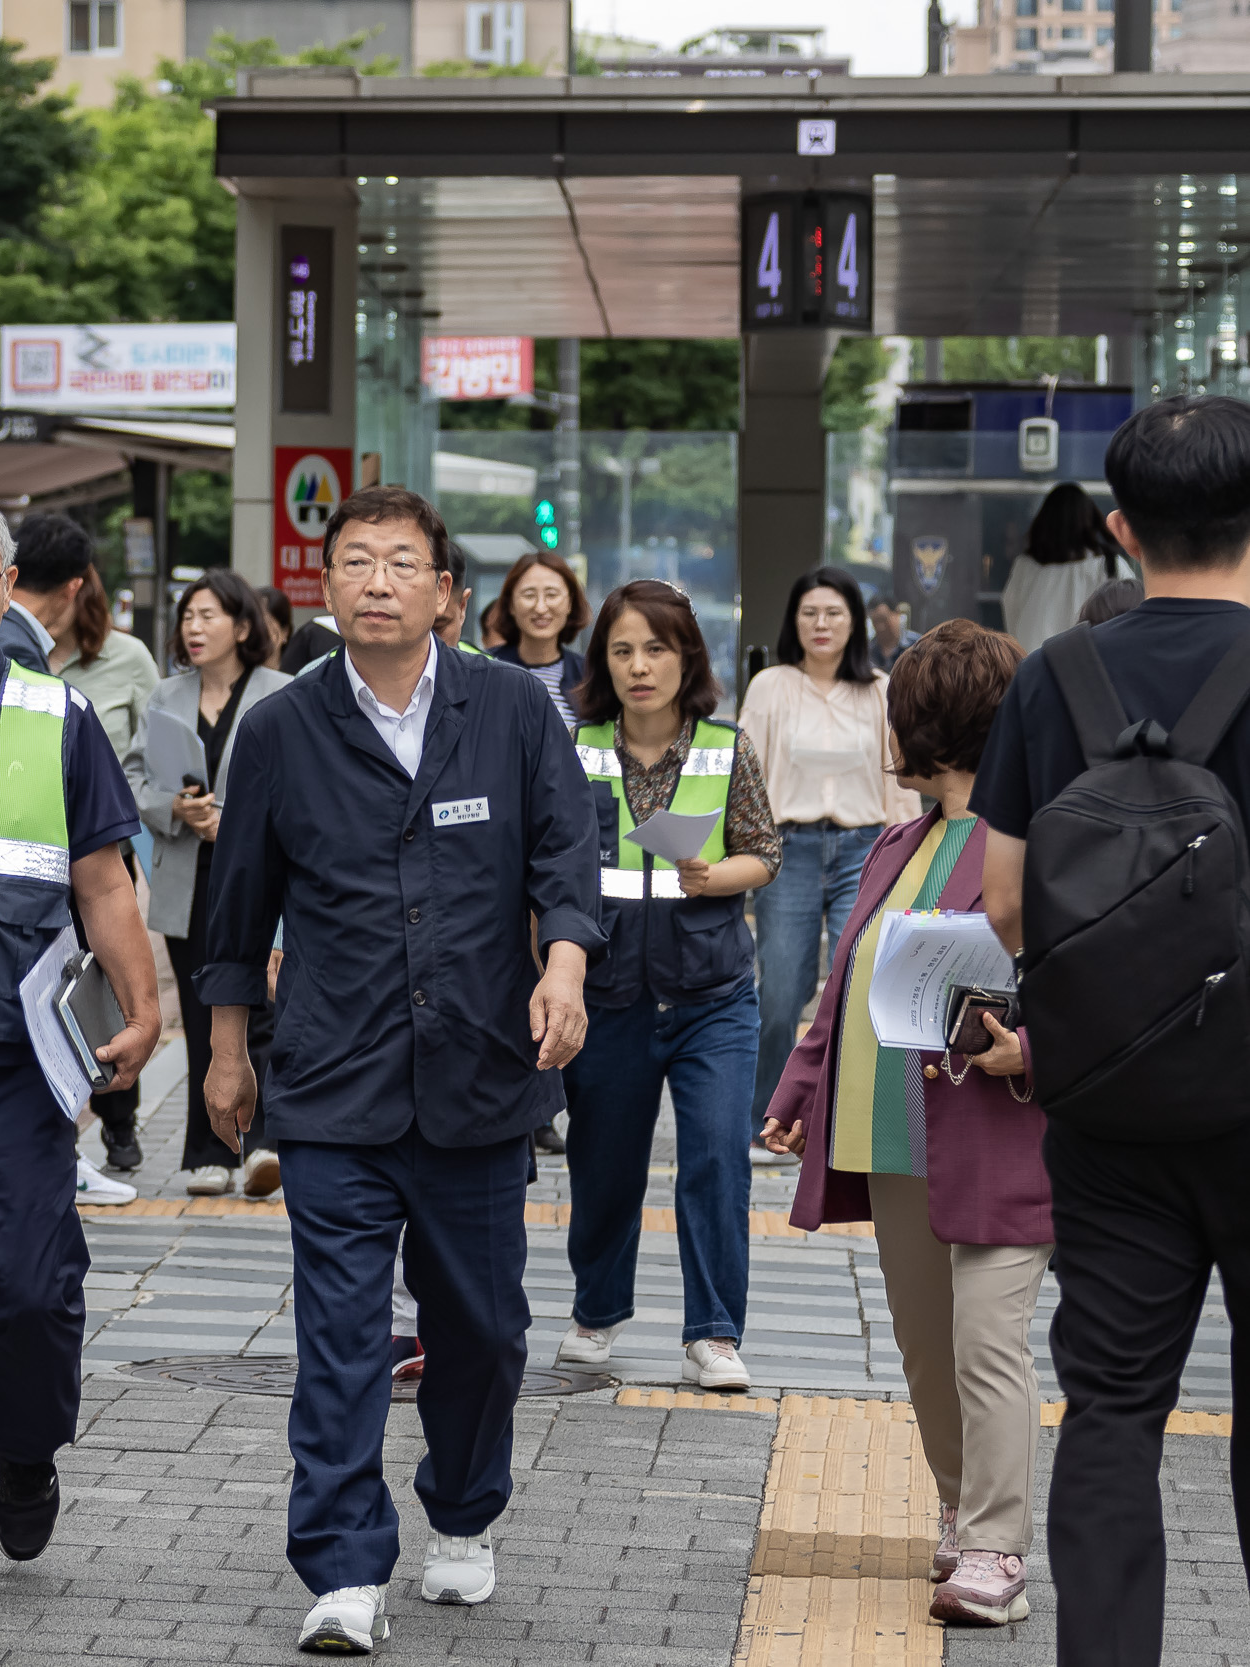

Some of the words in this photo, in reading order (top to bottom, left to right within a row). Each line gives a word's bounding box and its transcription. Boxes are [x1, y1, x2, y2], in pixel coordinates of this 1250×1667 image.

[757, 211, 782, 299] 4
[837, 212, 859, 299] 4
[281, 546, 323, 570] 대피
